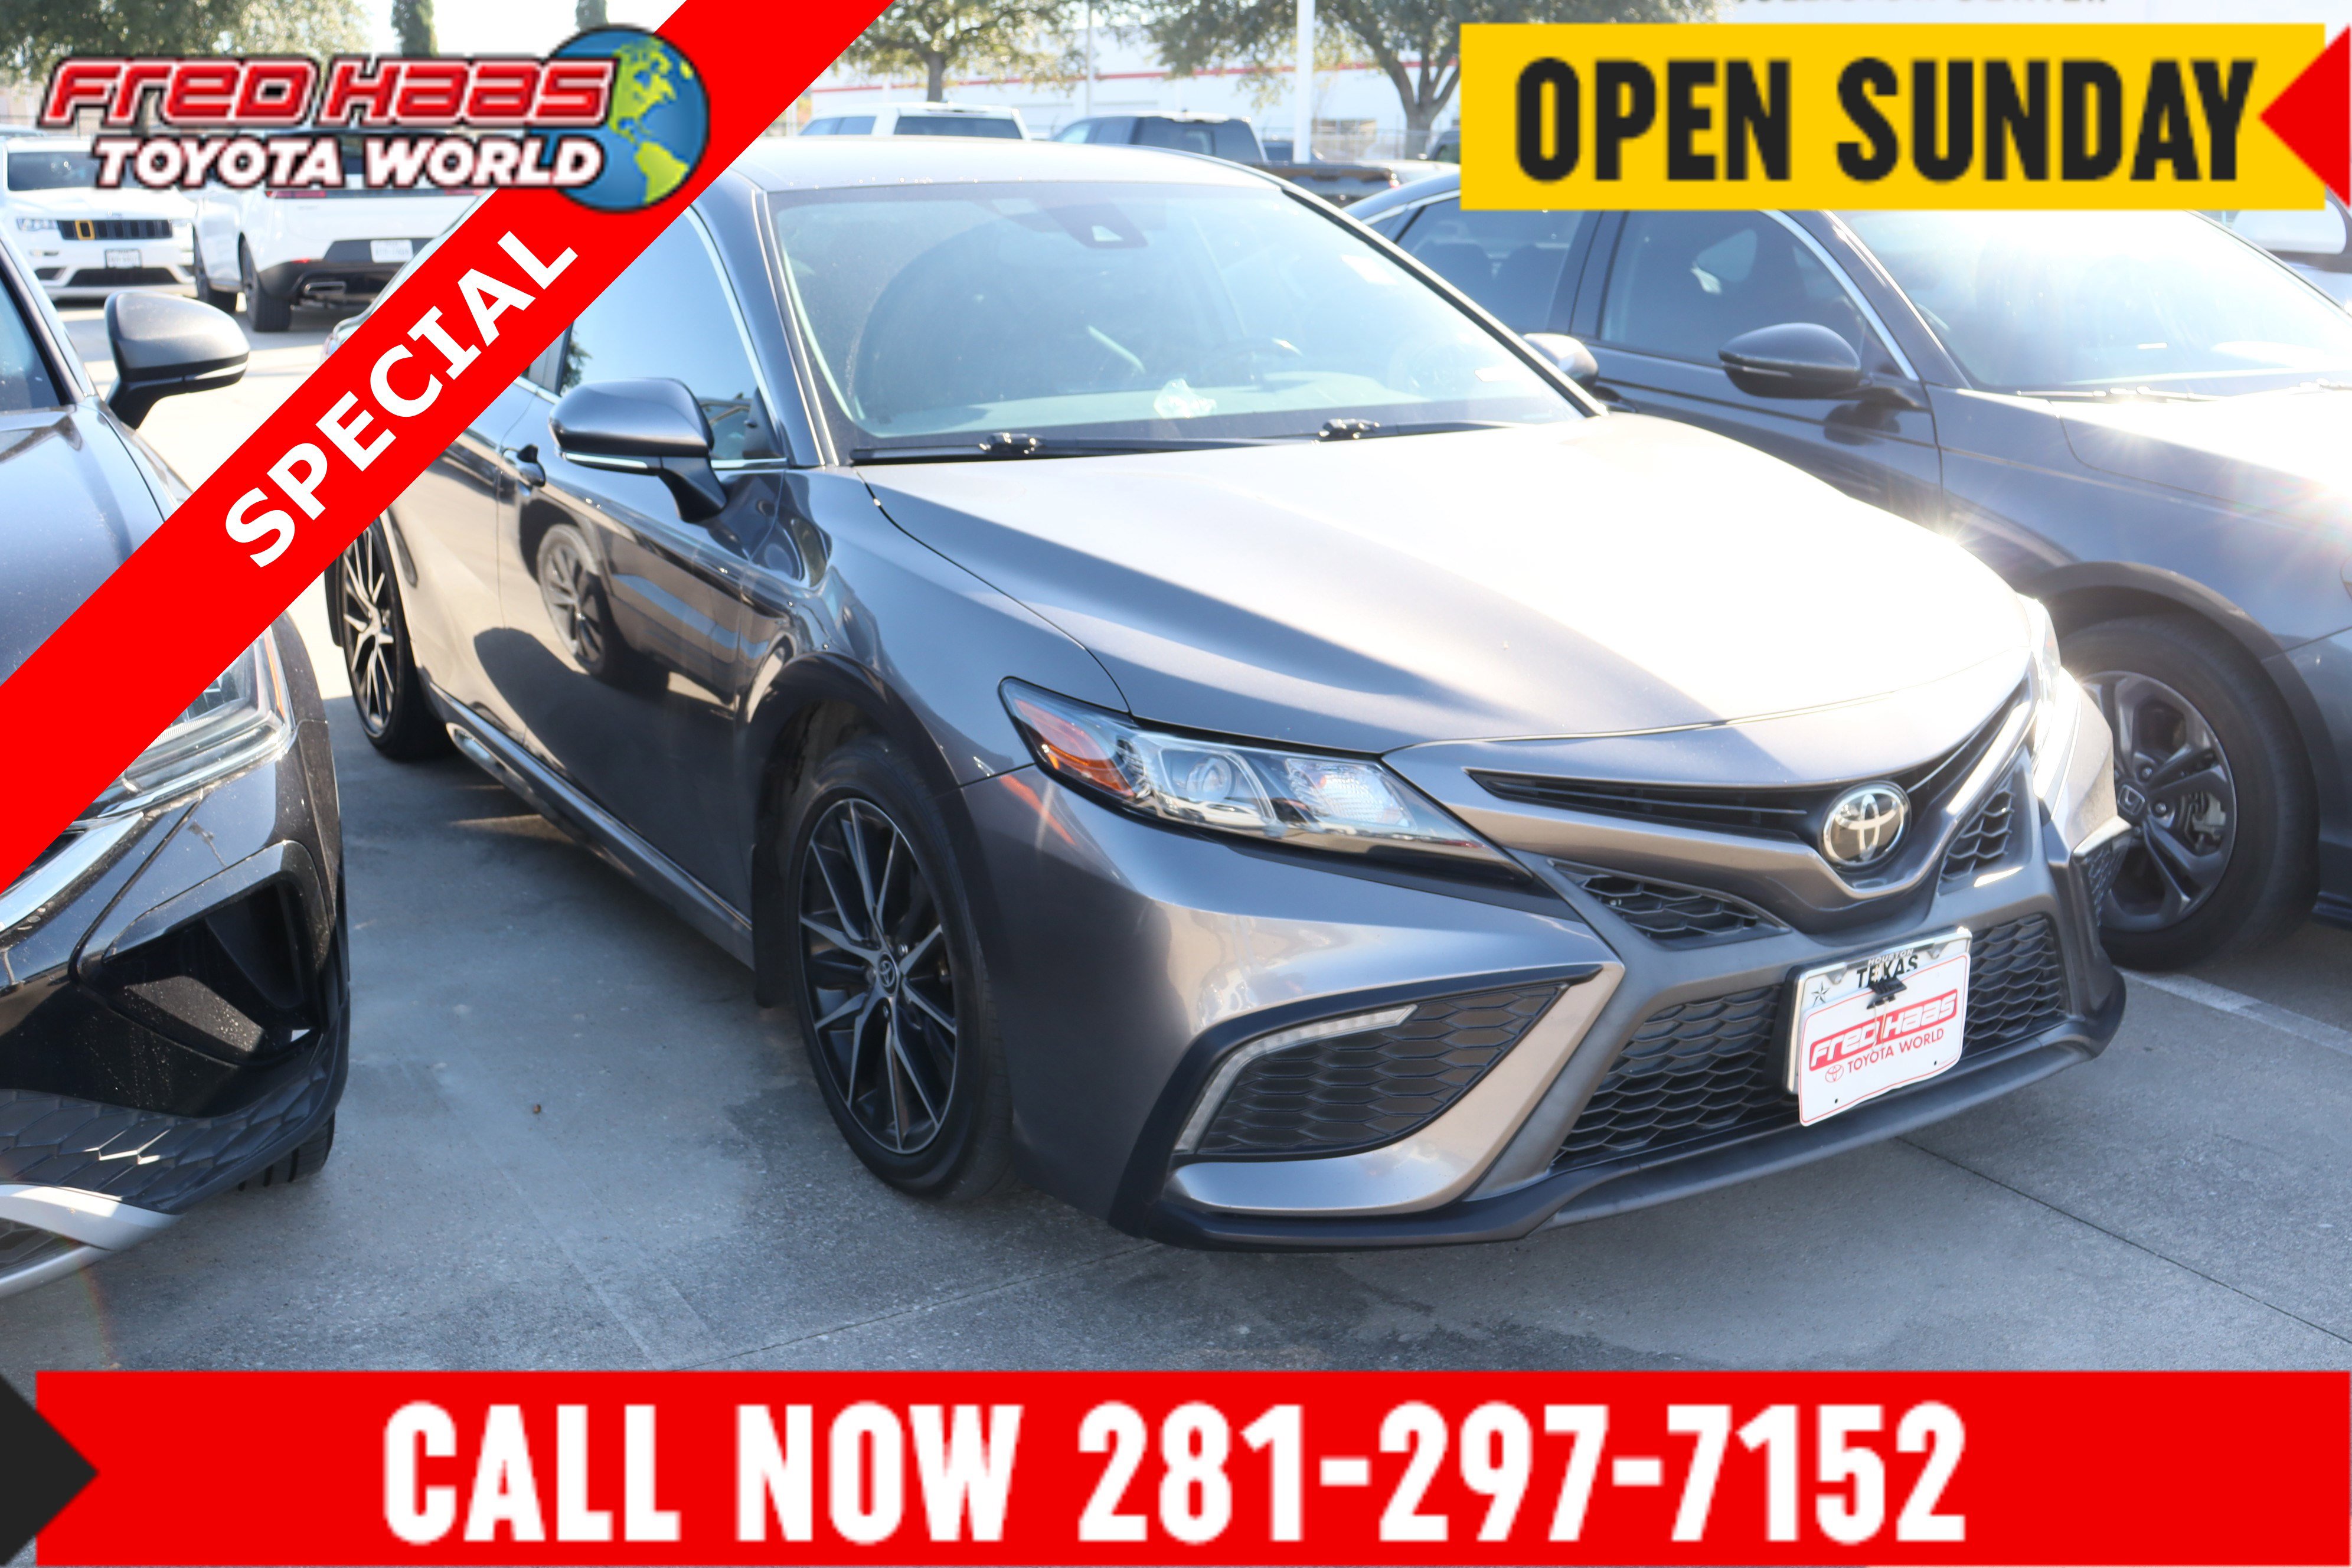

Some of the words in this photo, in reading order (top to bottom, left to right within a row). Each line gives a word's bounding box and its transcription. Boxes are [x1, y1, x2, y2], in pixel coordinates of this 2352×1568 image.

[1857, 955, 1918, 988] TEXAS
[1867, 948, 1914, 965] HOUSTON
[1847, 1047, 1894, 1074] TOYOTA
[1899, 1028, 1944, 1054] WORLD
